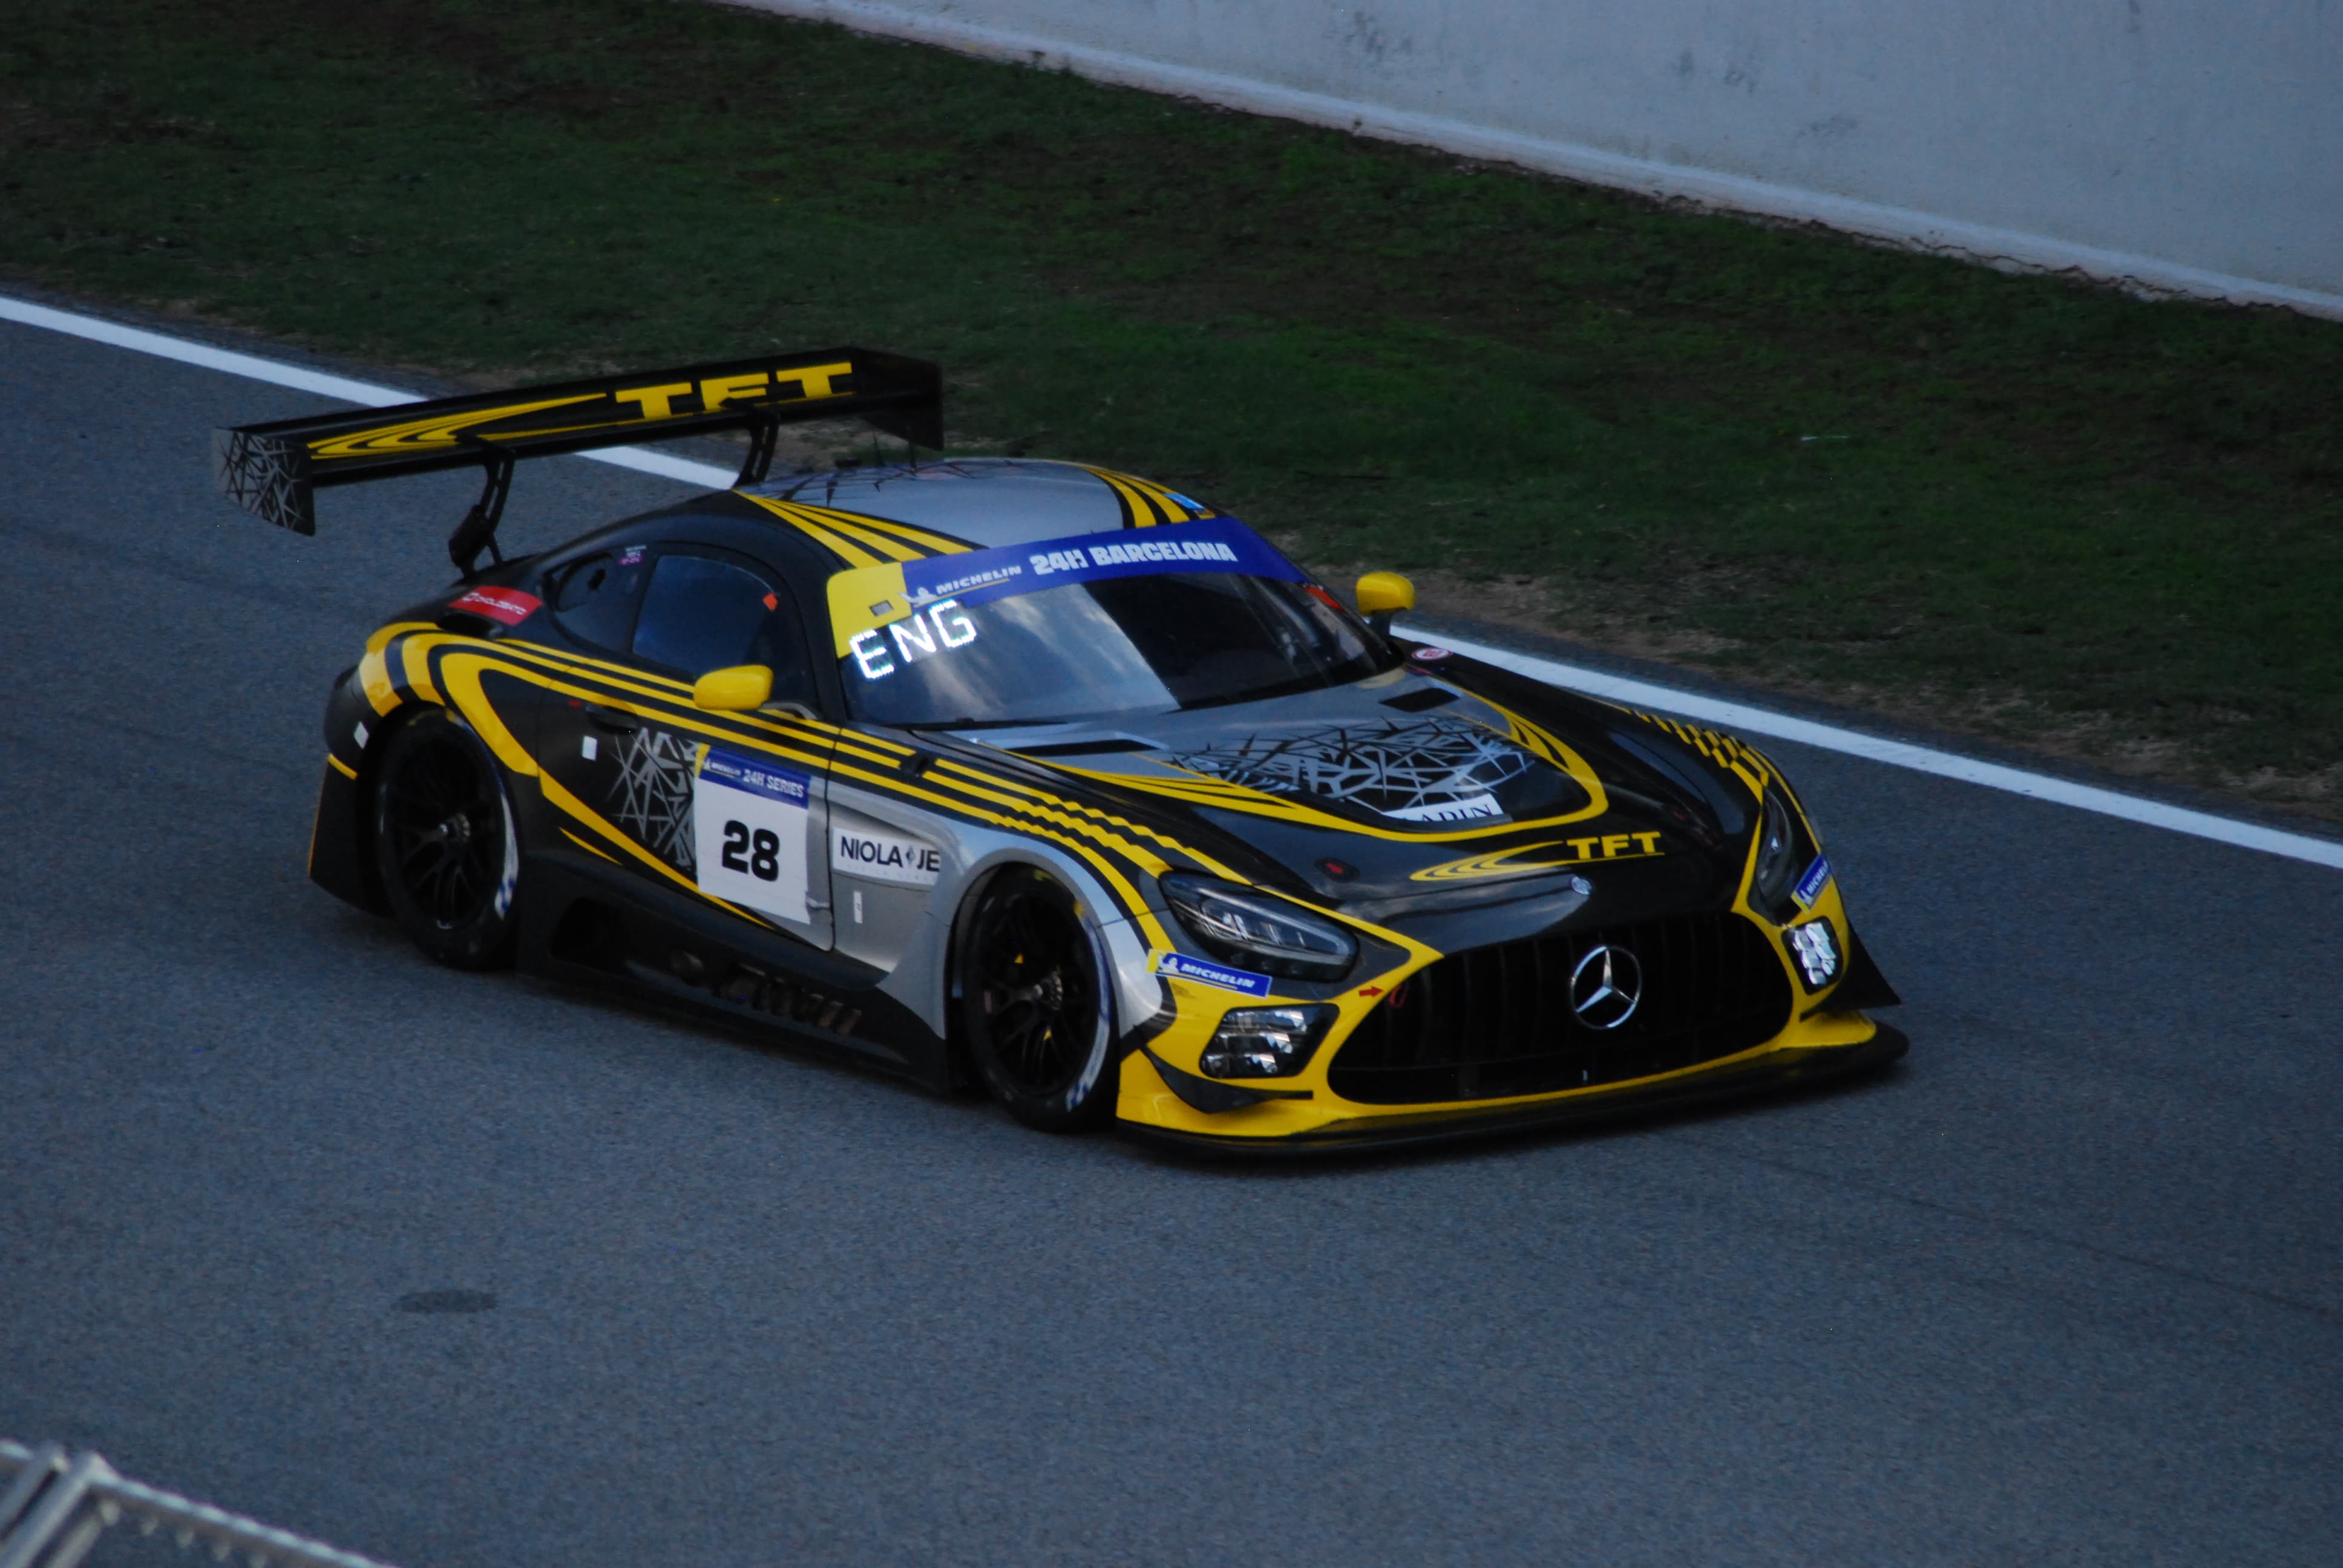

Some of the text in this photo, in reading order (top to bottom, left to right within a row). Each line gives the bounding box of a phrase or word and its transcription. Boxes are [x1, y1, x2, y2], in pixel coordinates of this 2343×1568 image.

[615, 362, 852, 419] TFT
[936, 541, 1239, 595] MICHELIN 24H BARCELONA
[849, 598, 977, 679] ENG
[742, 769, 766, 786] 24H
[767, 775, 804, 799] SERIES
[722, 820, 779, 881] 28
[841, 835, 903, 868] NIOLA
[1566, 831, 1661, 860] TFT
[1181, 963, 1256, 988] MICHELIN
